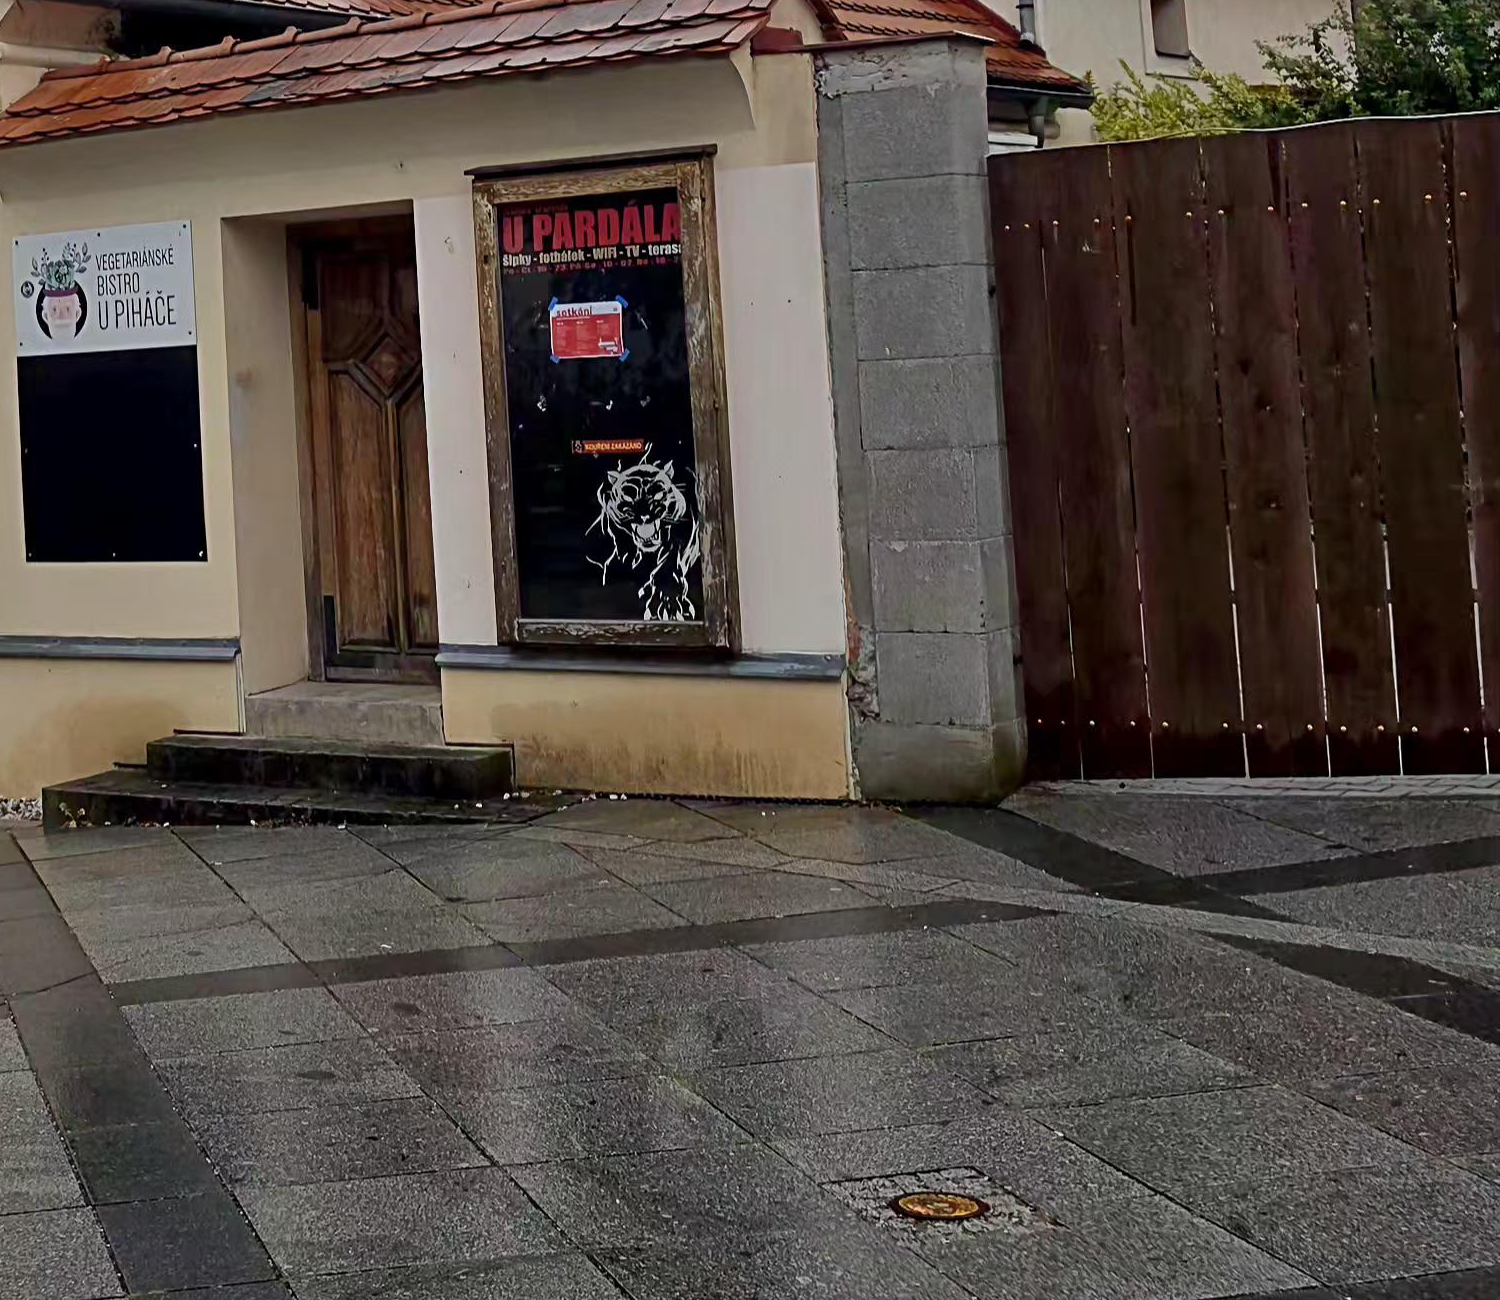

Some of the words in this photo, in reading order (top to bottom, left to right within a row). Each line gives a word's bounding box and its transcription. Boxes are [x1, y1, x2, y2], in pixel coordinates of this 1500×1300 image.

[502, 216, 524, 254] U
[95, 244, 174, 271] VEGETARIÁNSKÉ
[624, 245, 640, 258] TV
[97, 272, 140, 296] BISTRO
[98, 301, 109, 330] U
[115, 290, 177, 329] PIHÁČE
